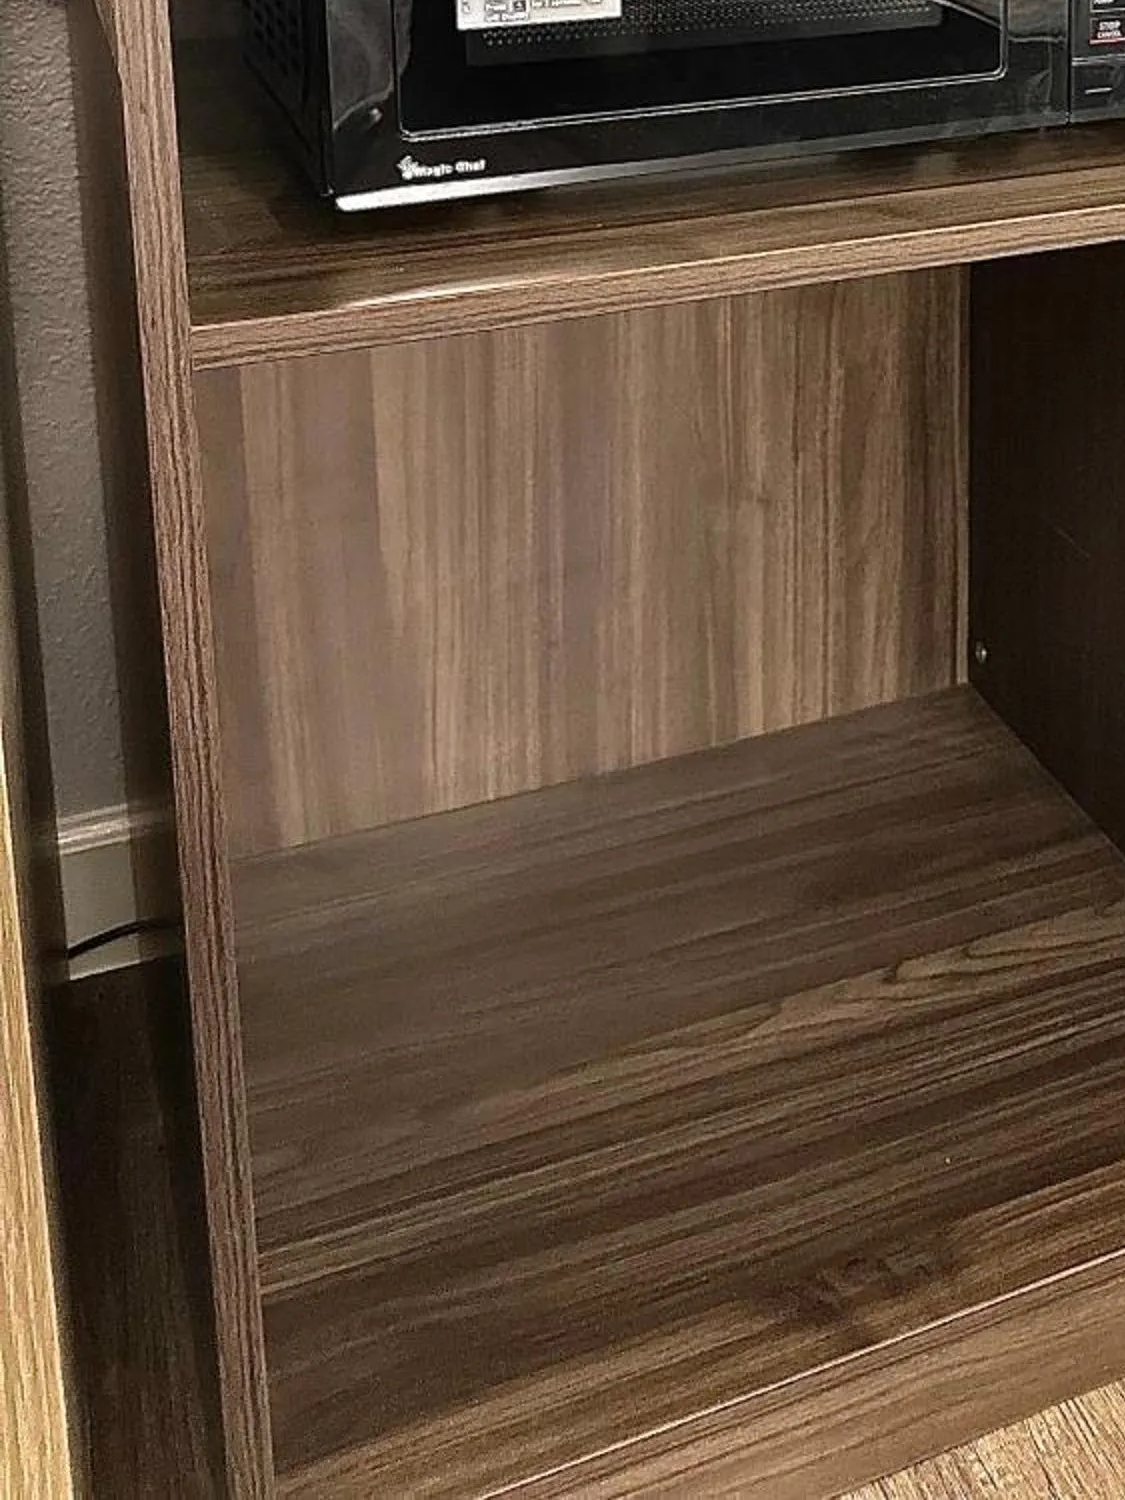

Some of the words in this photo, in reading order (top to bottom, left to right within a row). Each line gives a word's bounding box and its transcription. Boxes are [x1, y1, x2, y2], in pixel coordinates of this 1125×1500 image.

[1099, 20, 1121, 31] STOP
[413, 163, 454, 178] Magic
[455, 158, 486, 173] Chef
